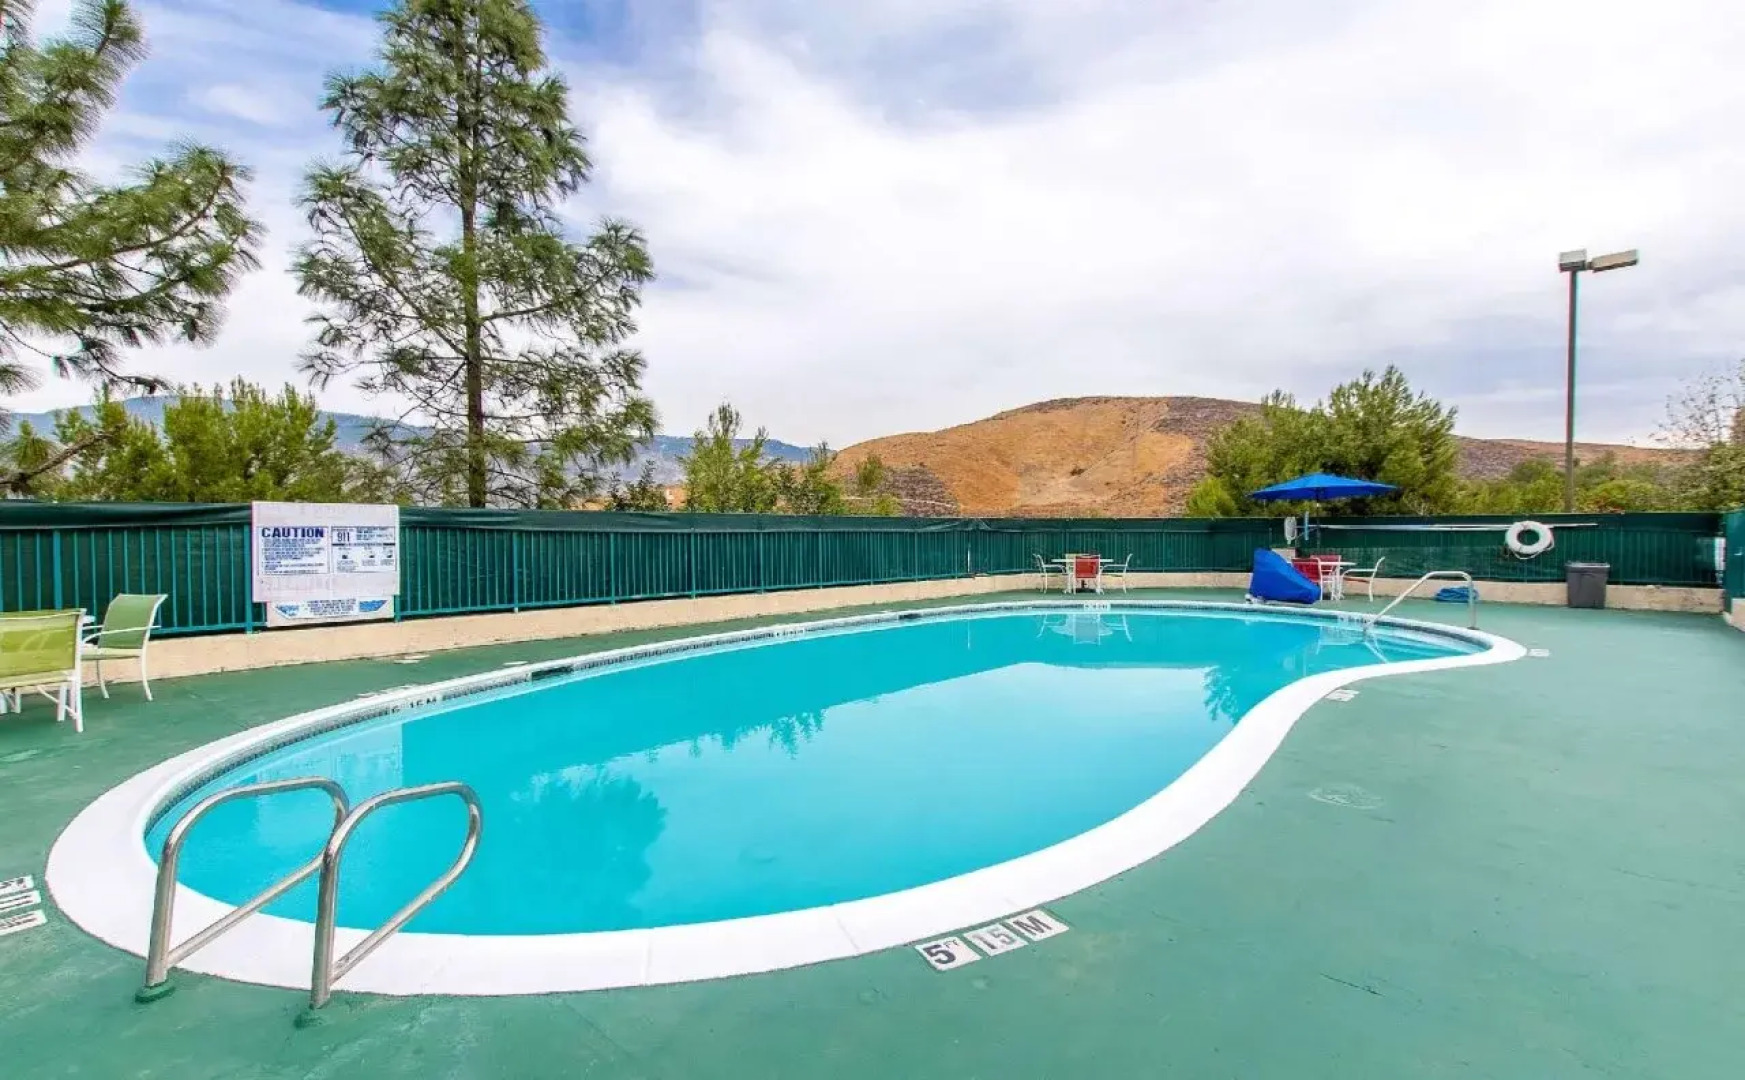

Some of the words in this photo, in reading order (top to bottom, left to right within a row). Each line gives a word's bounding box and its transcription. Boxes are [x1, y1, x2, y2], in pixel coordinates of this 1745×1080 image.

[261, 528, 324, 537] CAUTION
[337, 532, 350, 541] 911
[1011, 914, 1054, 936] M
